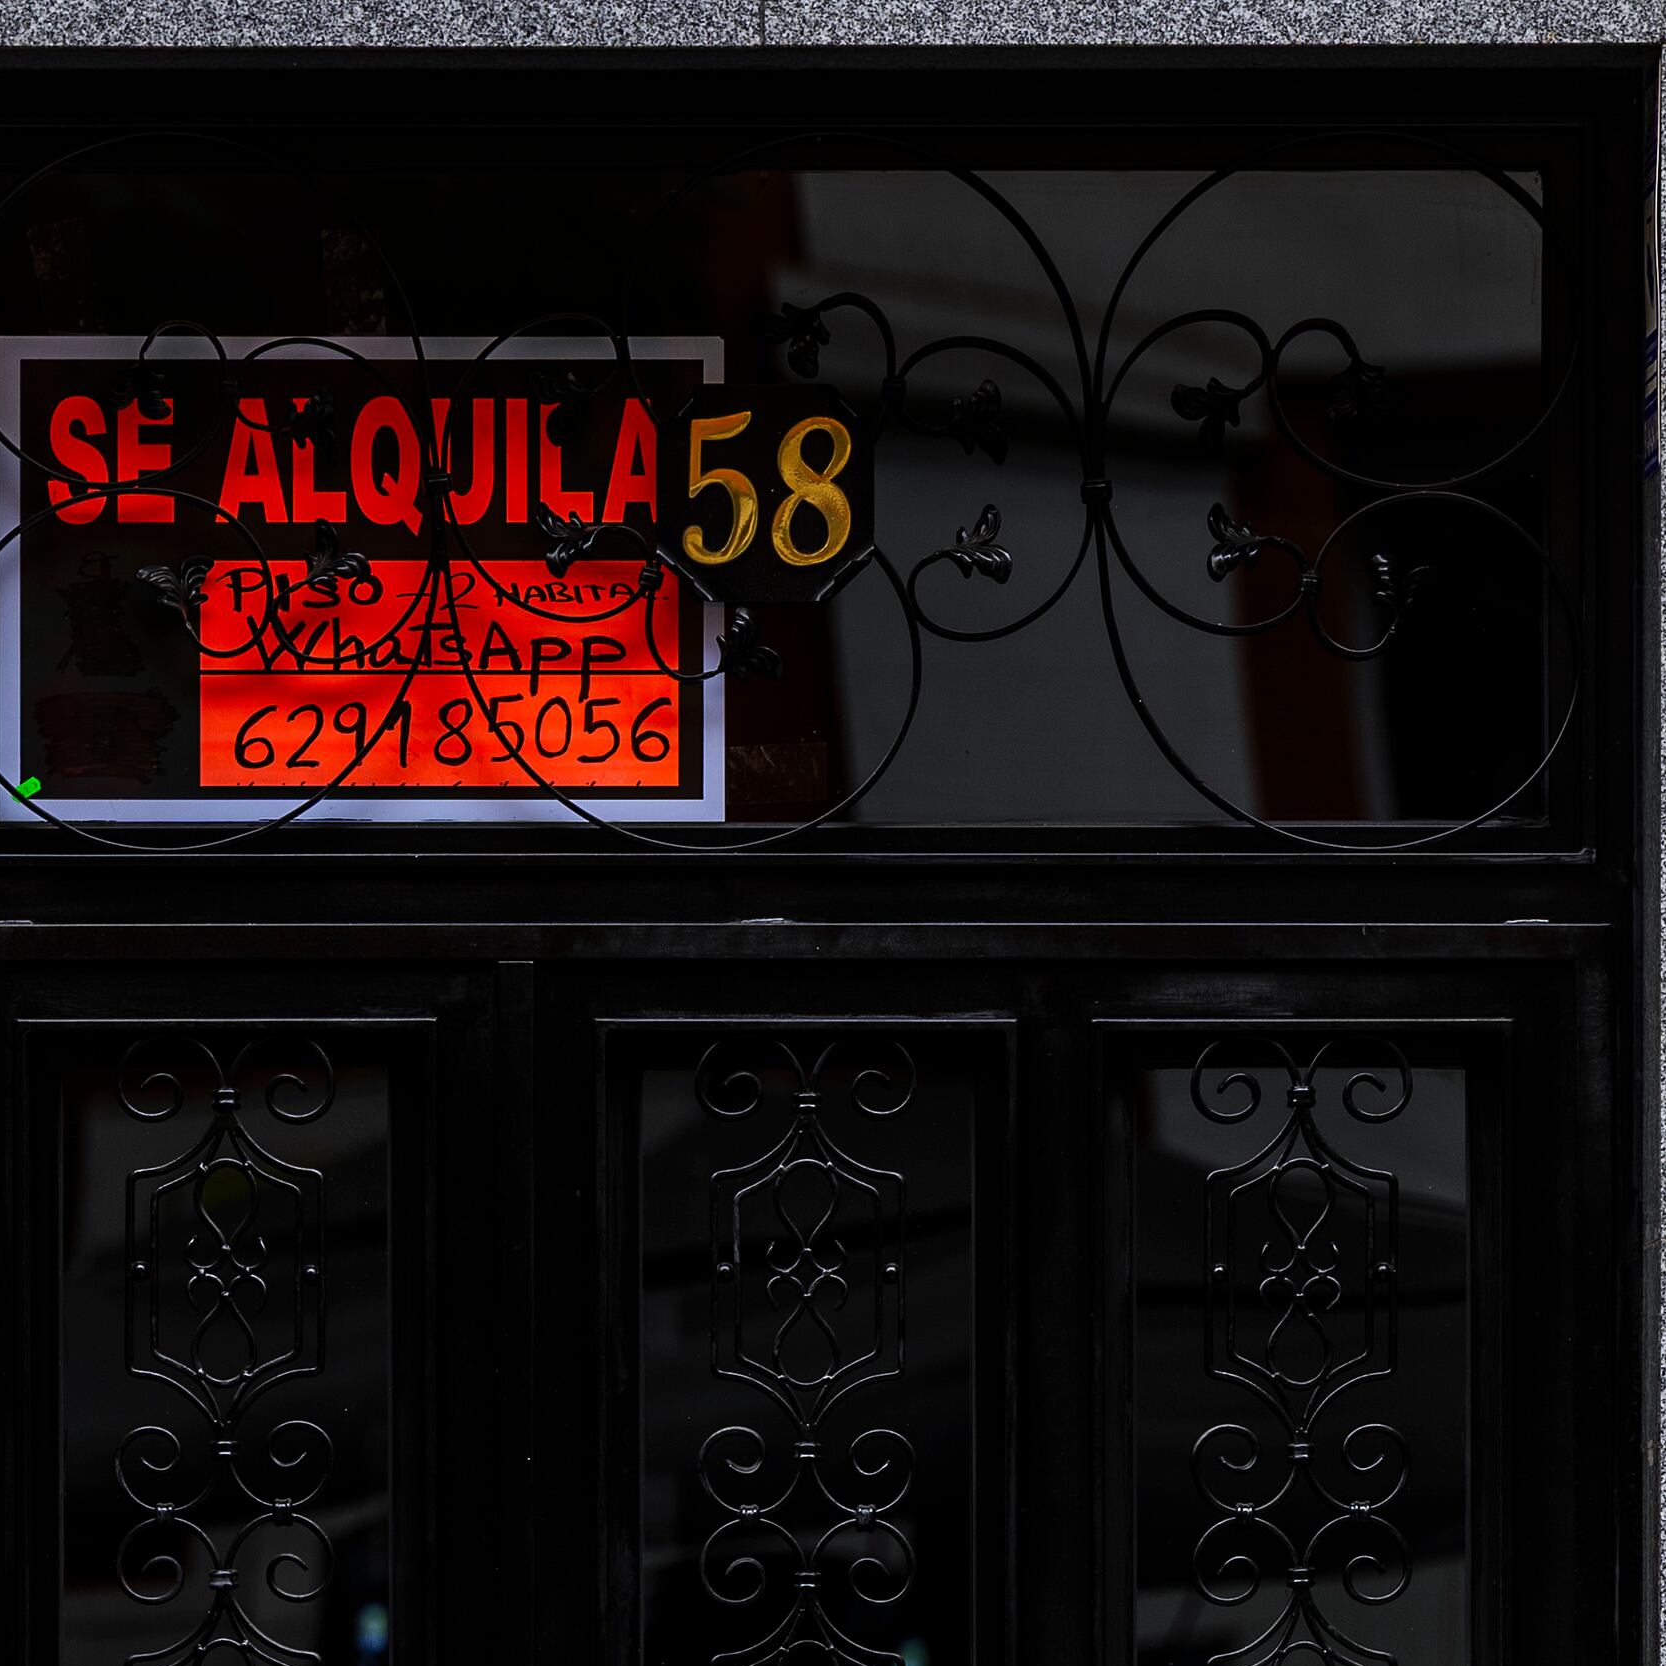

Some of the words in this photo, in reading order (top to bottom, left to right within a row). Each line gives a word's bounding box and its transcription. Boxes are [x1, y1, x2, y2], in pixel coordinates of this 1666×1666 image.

[47, 395, 175, 524] SE
[214, 396, 658, 536] ALQUILA
[681, 411, 851, 566] 58
[235, 694, 672, 768] 629185056
